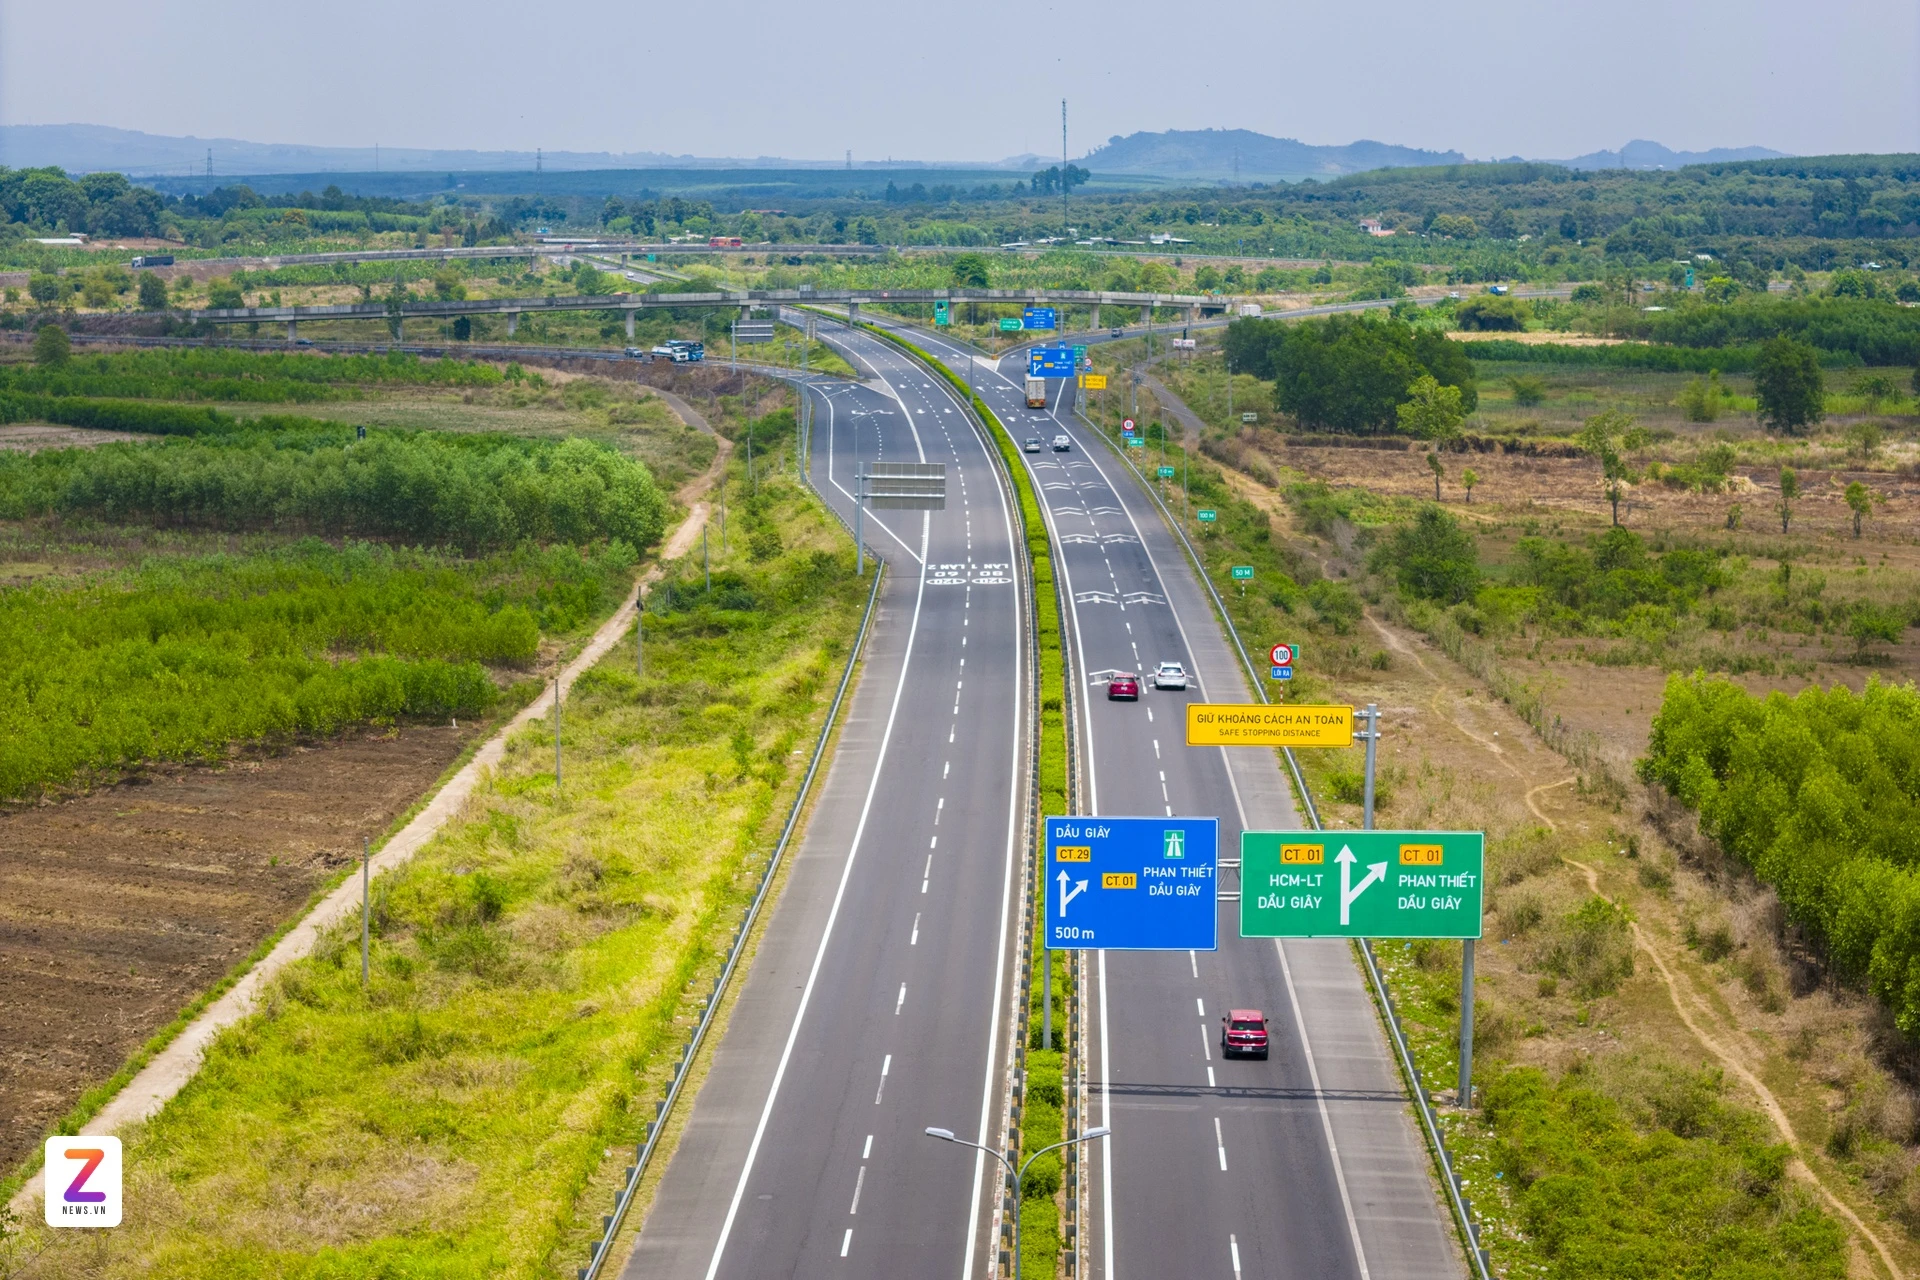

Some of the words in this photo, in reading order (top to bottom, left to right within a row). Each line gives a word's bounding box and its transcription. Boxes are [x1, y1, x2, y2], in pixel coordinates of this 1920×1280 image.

[1275, 650, 1288, 660] 100
[1218, 712, 1261, 724] KHOẢNG
[1264, 713, 1292, 724] CÁCH
[1296, 716, 1311, 724] AN
[1315, 714, 1343, 724] TOÀN
[1056, 824, 1079, 838] DẦU
[1085, 826, 1110, 838] GIÂY
[1060, 849, 1089, 859] CT.29
[1144, 867, 1176, 877] PHAN
[1181, 863, 1213, 877] THIẾT
[1106, 876, 1133, 886] CT.01
[1270, 874, 1323, 886] HCM-LT
[1398, 875, 1436, 887] PHAN
[1439, 871, 1476, 888] THIẾT
[1149, 882, 1172, 895] DẦU
[1176, 884, 1201, 896] GIÂY
[1258, 893, 1284, 908] DẦU
[1291, 895, 1322, 908] GIÂY
[1398, 894, 1425, 909] DẦU
[1431, 896, 1462, 910] GIÂY
[1056, 927, 1079, 939] 500
[1082, 930, 1094, 939] m
